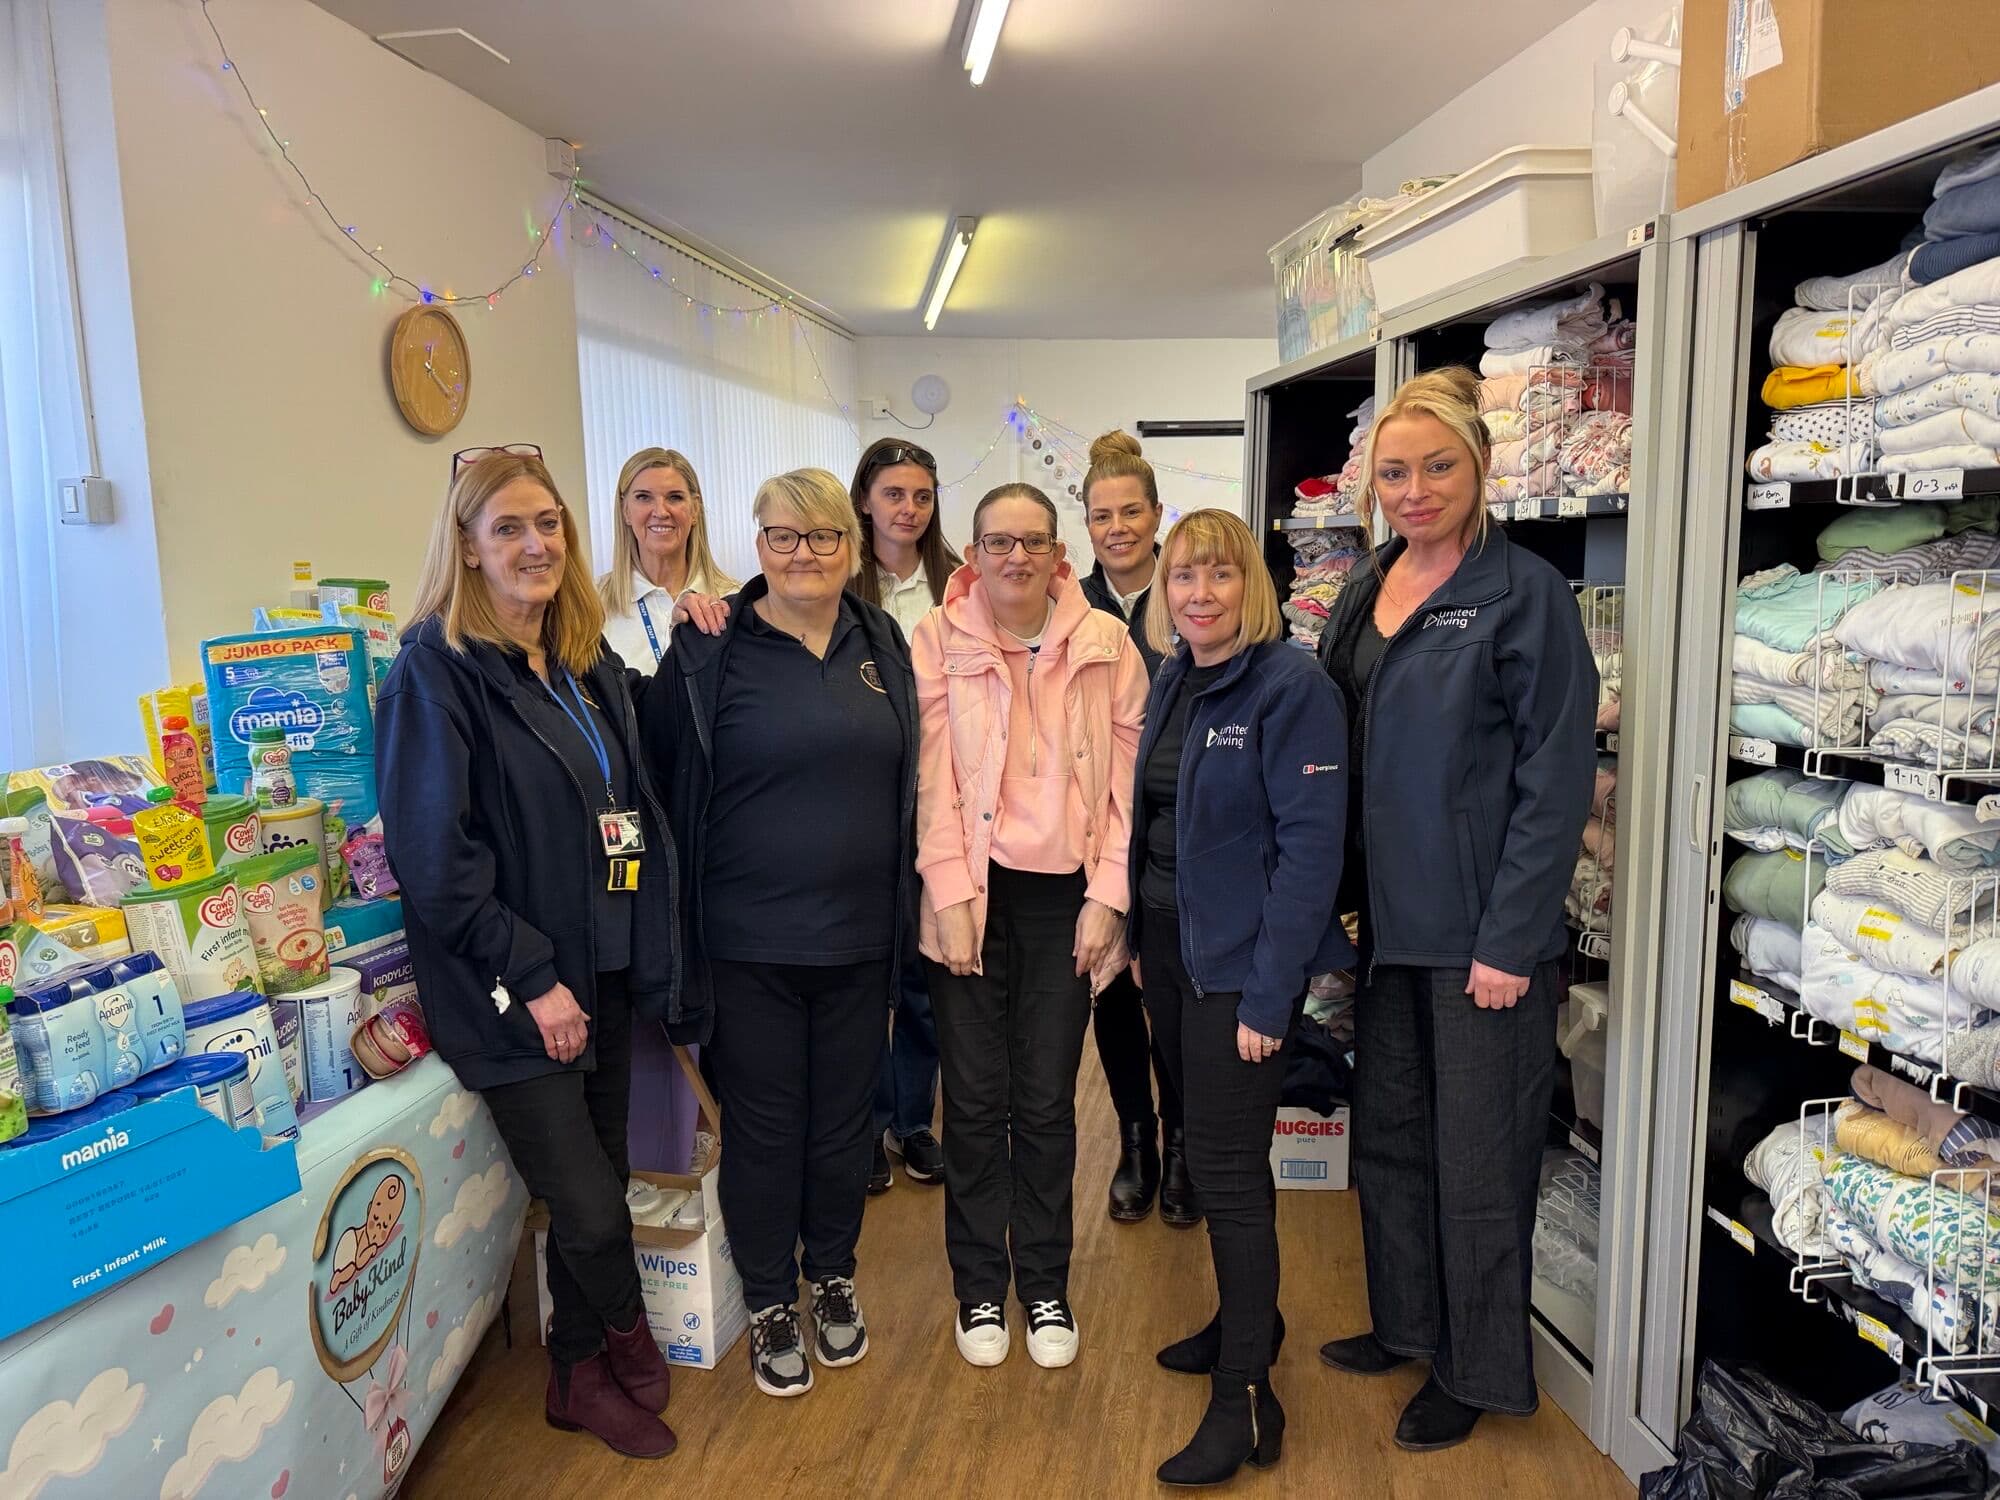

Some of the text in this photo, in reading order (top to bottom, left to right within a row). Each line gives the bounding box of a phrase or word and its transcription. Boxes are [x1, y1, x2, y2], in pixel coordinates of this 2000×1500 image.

[1631, 229, 1638, 241] 2
[1912, 478, 1940, 494] 0-3
[1439, 606, 1478, 618] united
[1436, 616, 1468, 629] living
[223, 637, 339, 660] JUMBO PACK
[225, 666, 235, 680] 5
[238, 698, 318, 733] mamia
[1216, 734, 1244, 750] living
[1894, 768, 1924, 787] 9-12
[149, 826, 201, 864] sweetcorn
[208, 900, 229, 914] Cow
[215, 905, 234, 921] Gate
[200, 939, 221, 962] First
[220, 927, 242, 946] infant
[373, 961, 413, 988] KiDDYLiCi
[99, 999, 135, 1021] Aptamil
[152, 994, 164, 1016] 1
[66, 1029, 89, 1044] Ready
[64, 1037, 91, 1054] to feed
[342, 1067, 353, 1090] 1
[1274, 1119, 1345, 1136] HUGGIES
[1296, 1136, 1316, 1144] pure
[61, 1127, 129, 1171] mamia
[71, 1236, 168, 1289] First Infant Milk
[640, 1252, 698, 1279] Wipes
[662, 1280, 689, 1290] FREE
